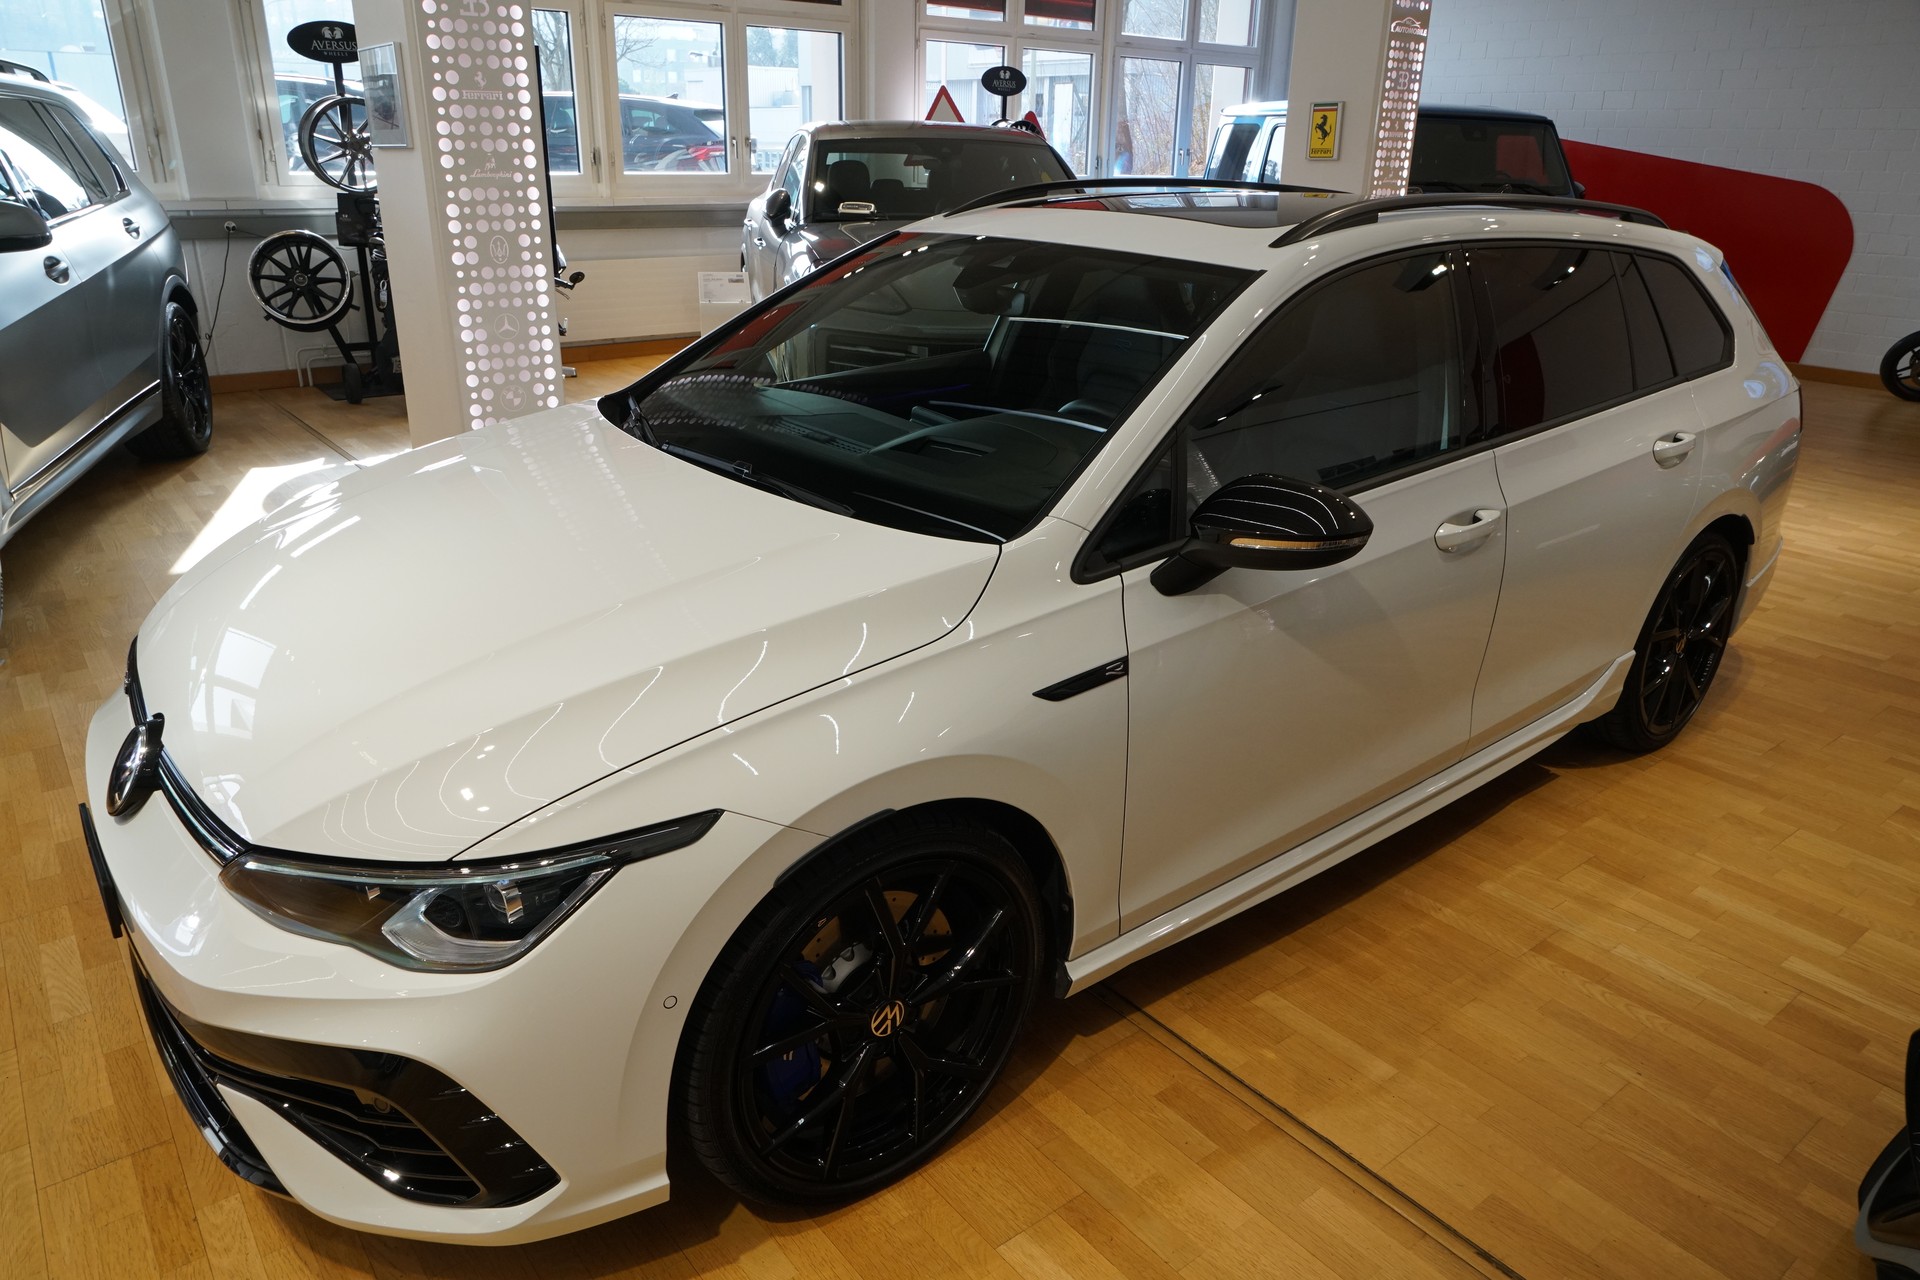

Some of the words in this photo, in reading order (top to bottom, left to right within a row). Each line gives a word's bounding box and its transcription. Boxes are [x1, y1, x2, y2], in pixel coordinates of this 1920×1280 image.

[1395, 26, 1427, 36] AUTOMOBILE
[311, 39, 358, 51] AVERSUS
[992, 79, 1016, 88] AVERSUS
[461, 90, 503, 100] Ferrari
[1310, 147, 1332, 155] Ferrari
[1105, 661, 1126, 676] R
